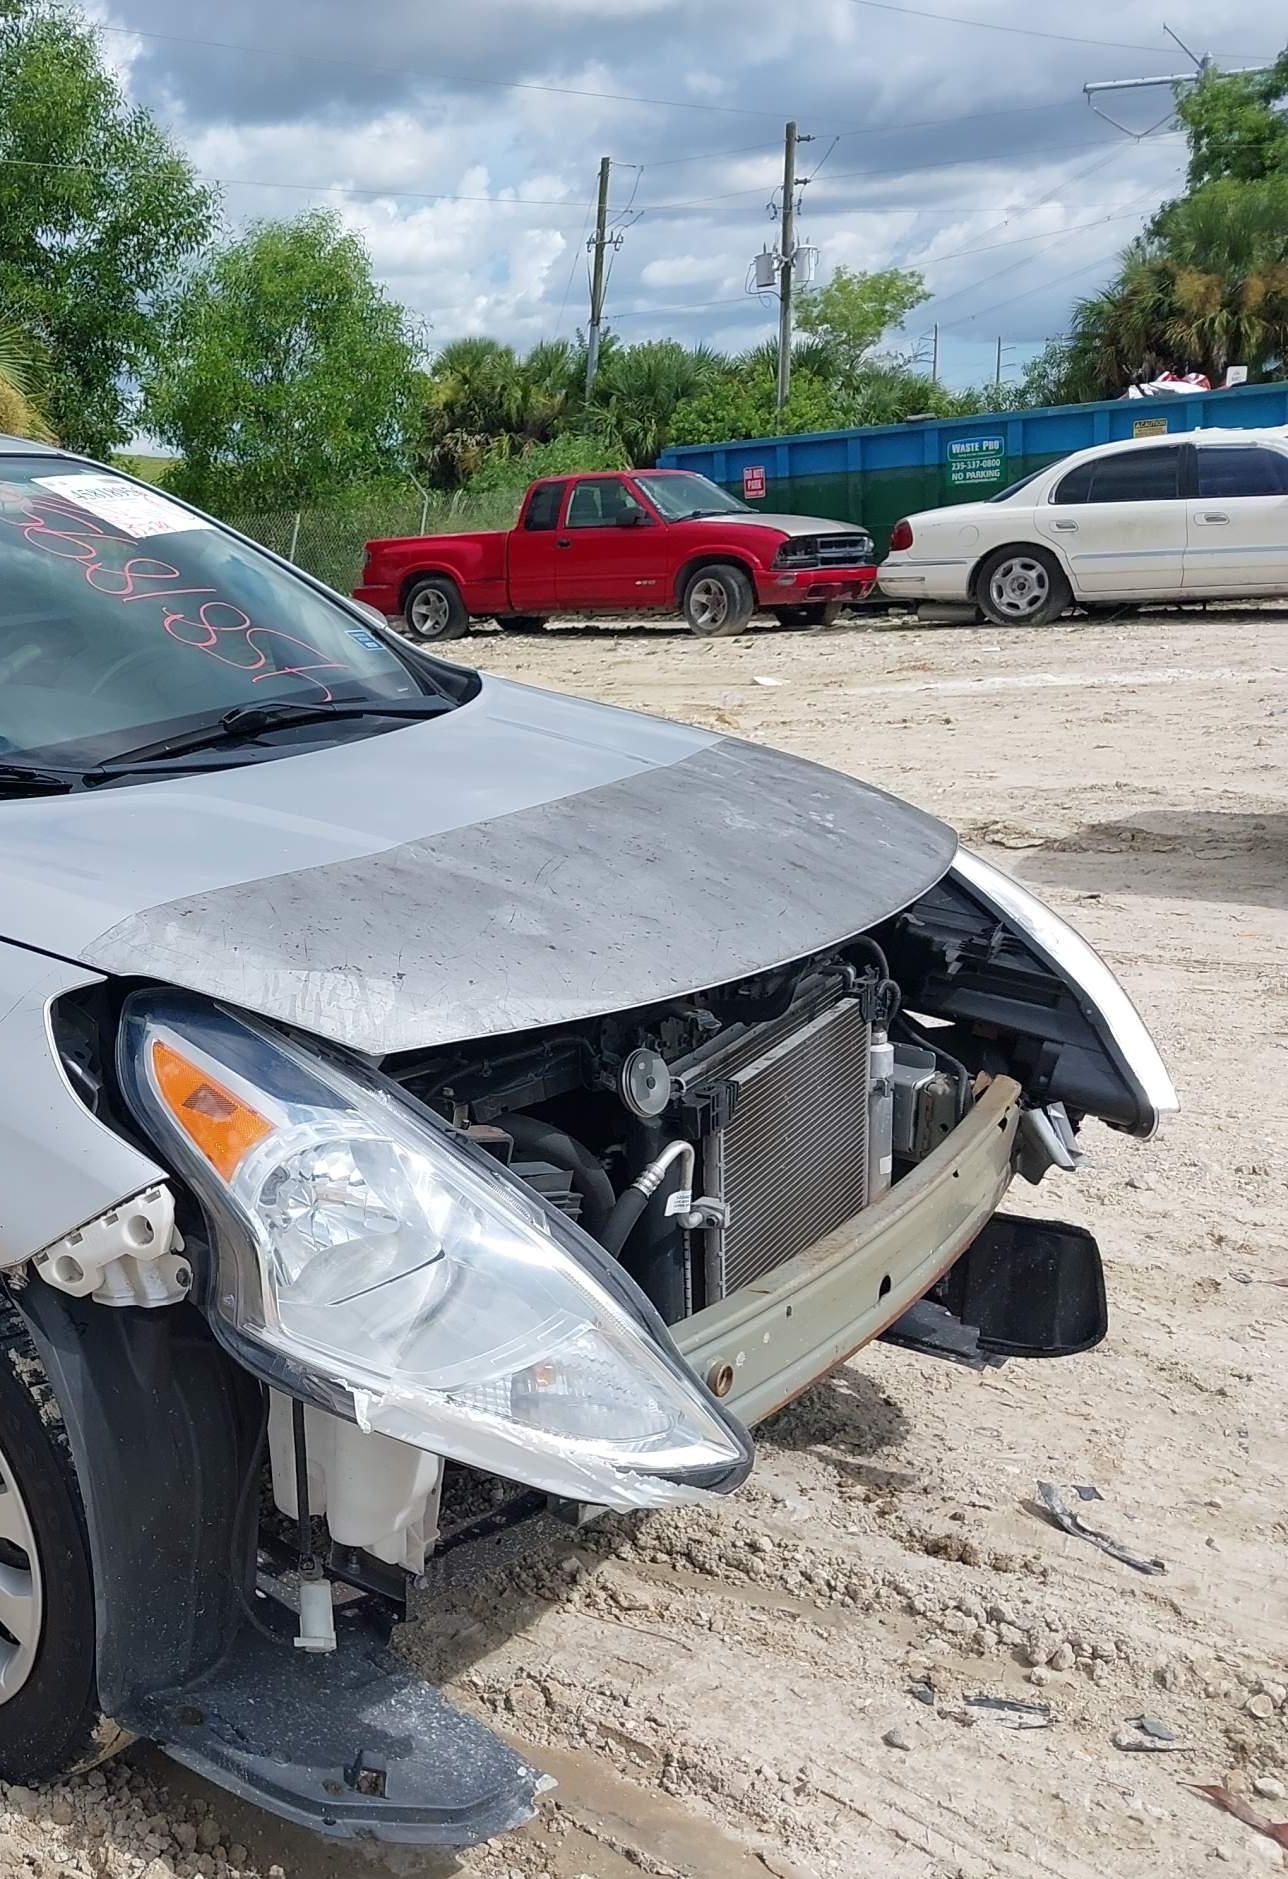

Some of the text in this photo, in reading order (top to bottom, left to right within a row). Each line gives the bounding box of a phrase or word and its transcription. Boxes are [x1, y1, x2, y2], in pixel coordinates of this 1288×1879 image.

[952, 442, 980, 454] WASTE
[951, 469, 1001, 481] NO PARKING
